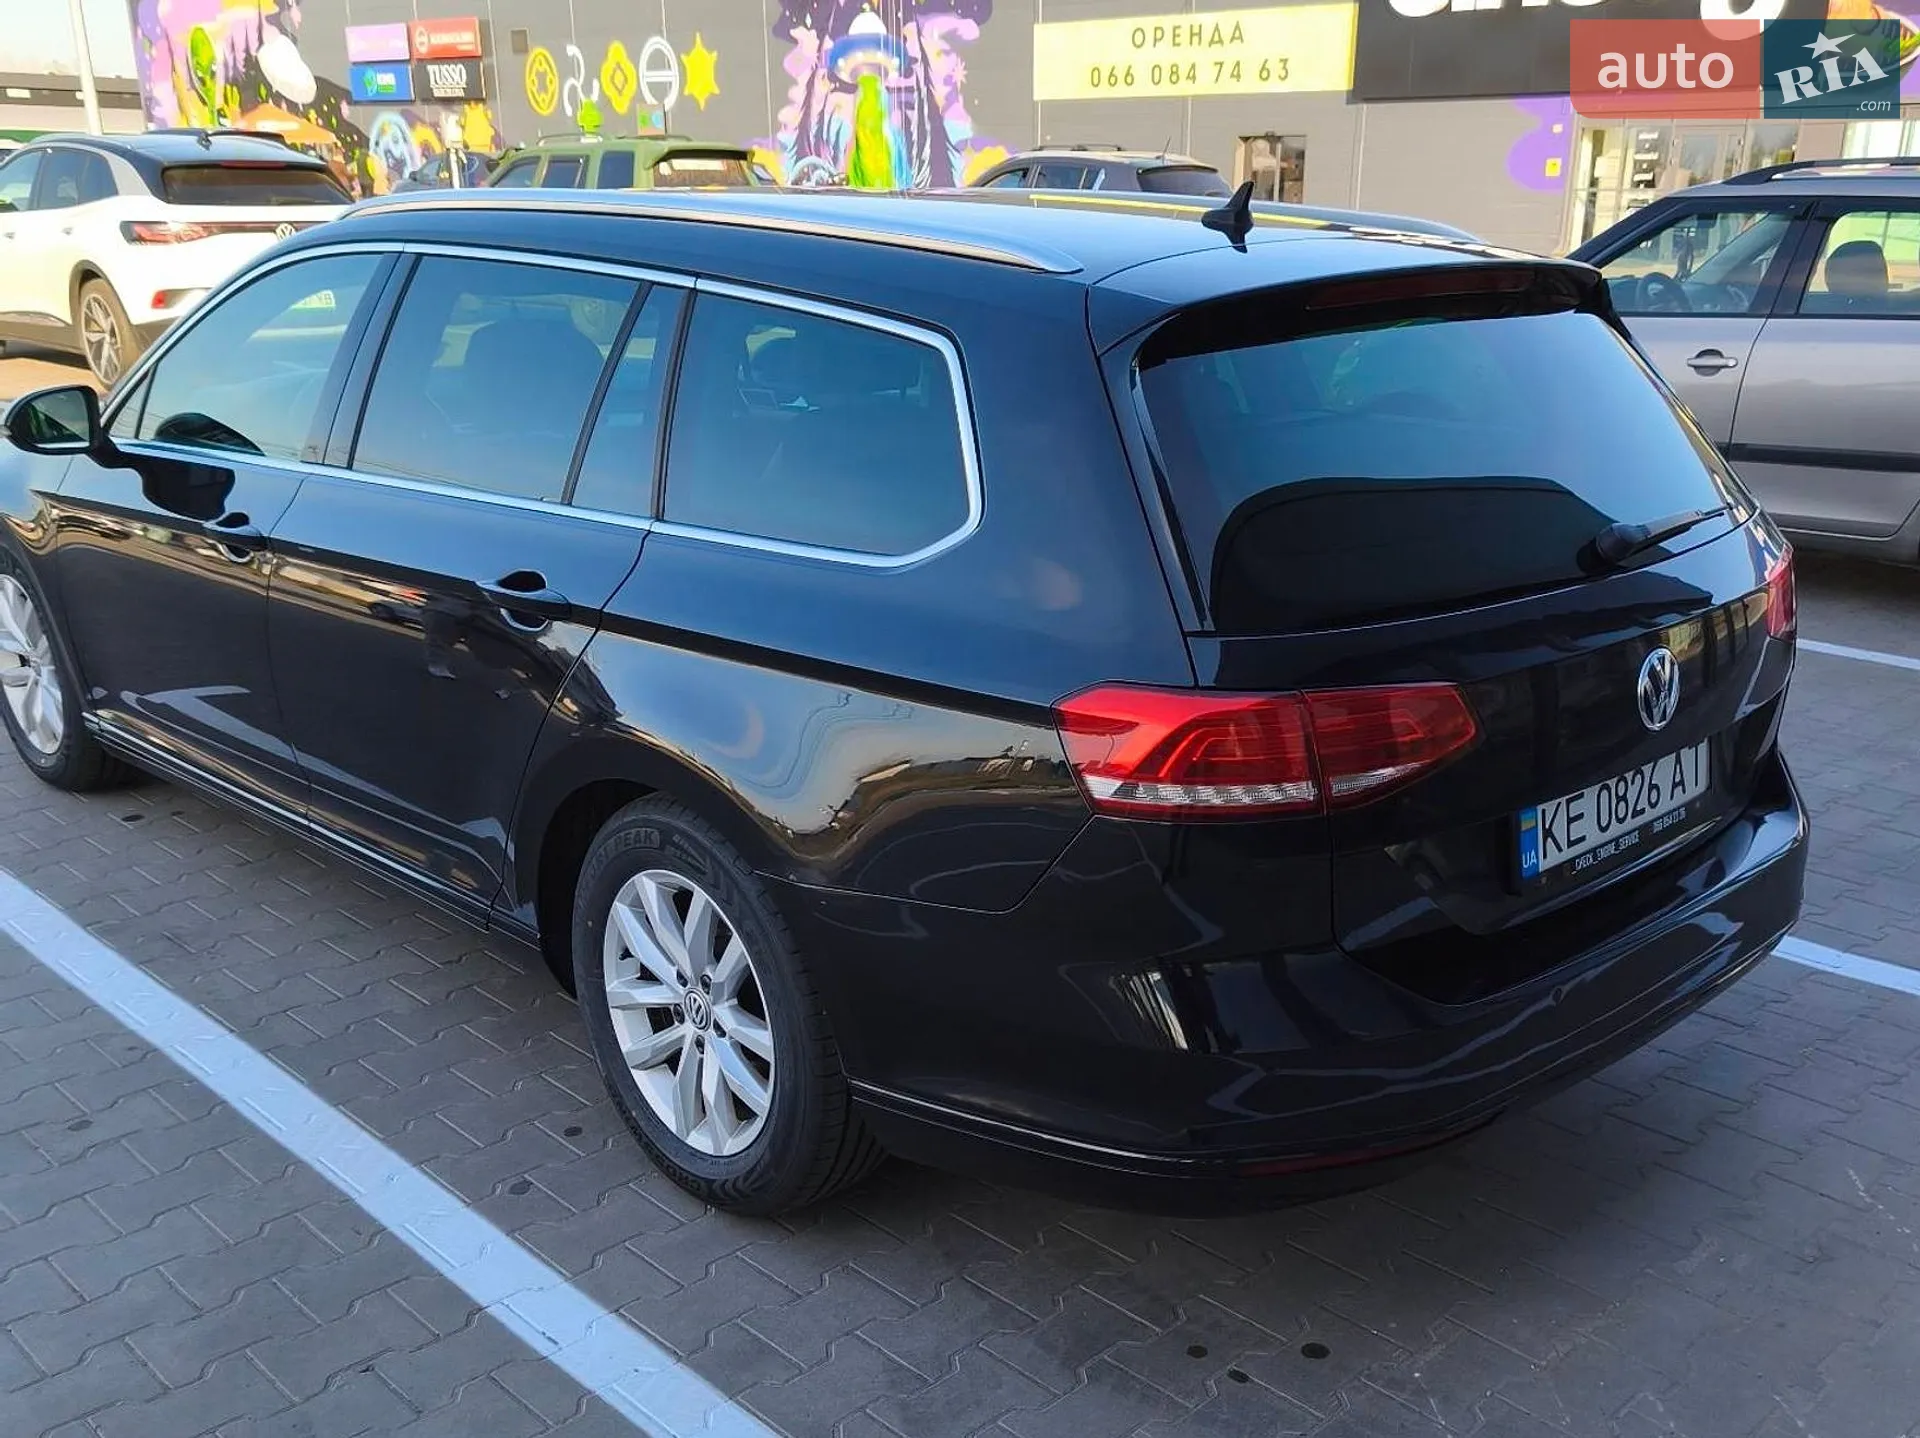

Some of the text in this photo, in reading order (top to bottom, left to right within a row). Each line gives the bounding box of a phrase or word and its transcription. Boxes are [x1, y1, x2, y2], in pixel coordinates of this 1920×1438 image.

[1132, 21, 1244, 48] ОРЕНДА
[426, 64, 467, 88] TUSSO
[1090, 58, 1290, 88] 066 084 74 63
[1541, 791, 1587, 860] KE
[1596, 760, 1661, 834] 0826
[1522, 851, 1538, 869] UA
